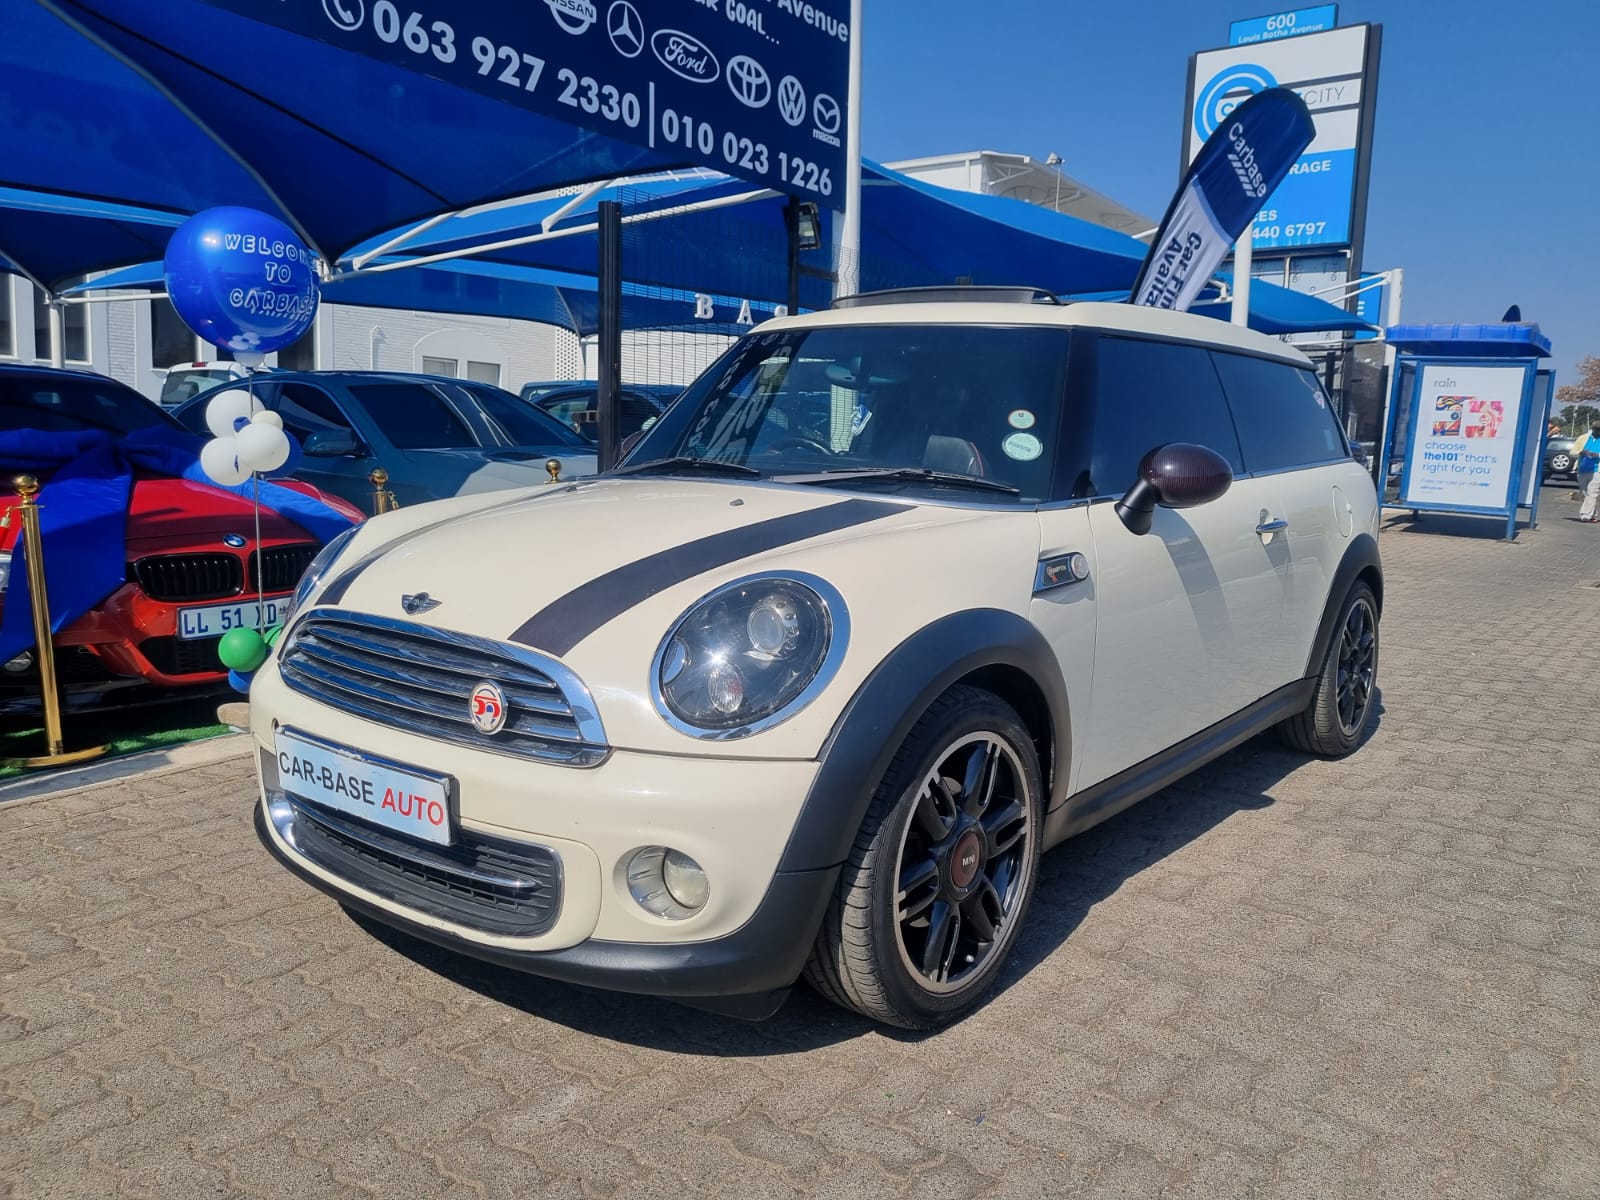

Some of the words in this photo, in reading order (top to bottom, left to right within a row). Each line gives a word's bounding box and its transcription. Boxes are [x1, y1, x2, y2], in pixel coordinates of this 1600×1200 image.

[551, 0, 594, 18] SSAN
[777, 0, 849, 42] Avenue
[1266, 13, 1296, 31] 600
[1238, 32, 1260, 44] Louis
[1262, 28, 1288, 40] Botha
[1289, 23, 1324, 35] Avenue
[663, 36, 708, 75] Ford
[373, 0, 457, 64] 063
[471, 36, 545, 92] 927
[557, 68, 641, 128] 2330
[662, 108, 714, 155] 010
[722, 131, 769, 174] 023
[778, 152, 832, 196] 1226
[1304, 86, 1345, 105] CITY
[1228, 122, 1267, 198] Carbase
[1285, 222, 1326, 237] 6797
[225, 233, 313, 265] WELCO
[1179, 232, 1202, 271] Car
[265, 261, 291, 283] TO
[1433, 378, 1456, 388] rain
[1425, 442, 1466, 451] choose
[1465, 454, 1497, 463] that's
[1423, 463, 1447, 474] right
[1451, 463, 1465, 472] for
[1469, 466, 1490, 476] you
[183, 613, 208, 635] LL
[221, 607, 244, 630] 51
[278, 751, 376, 806] CAR-BASE
[381, 787, 445, 826] AUTO
